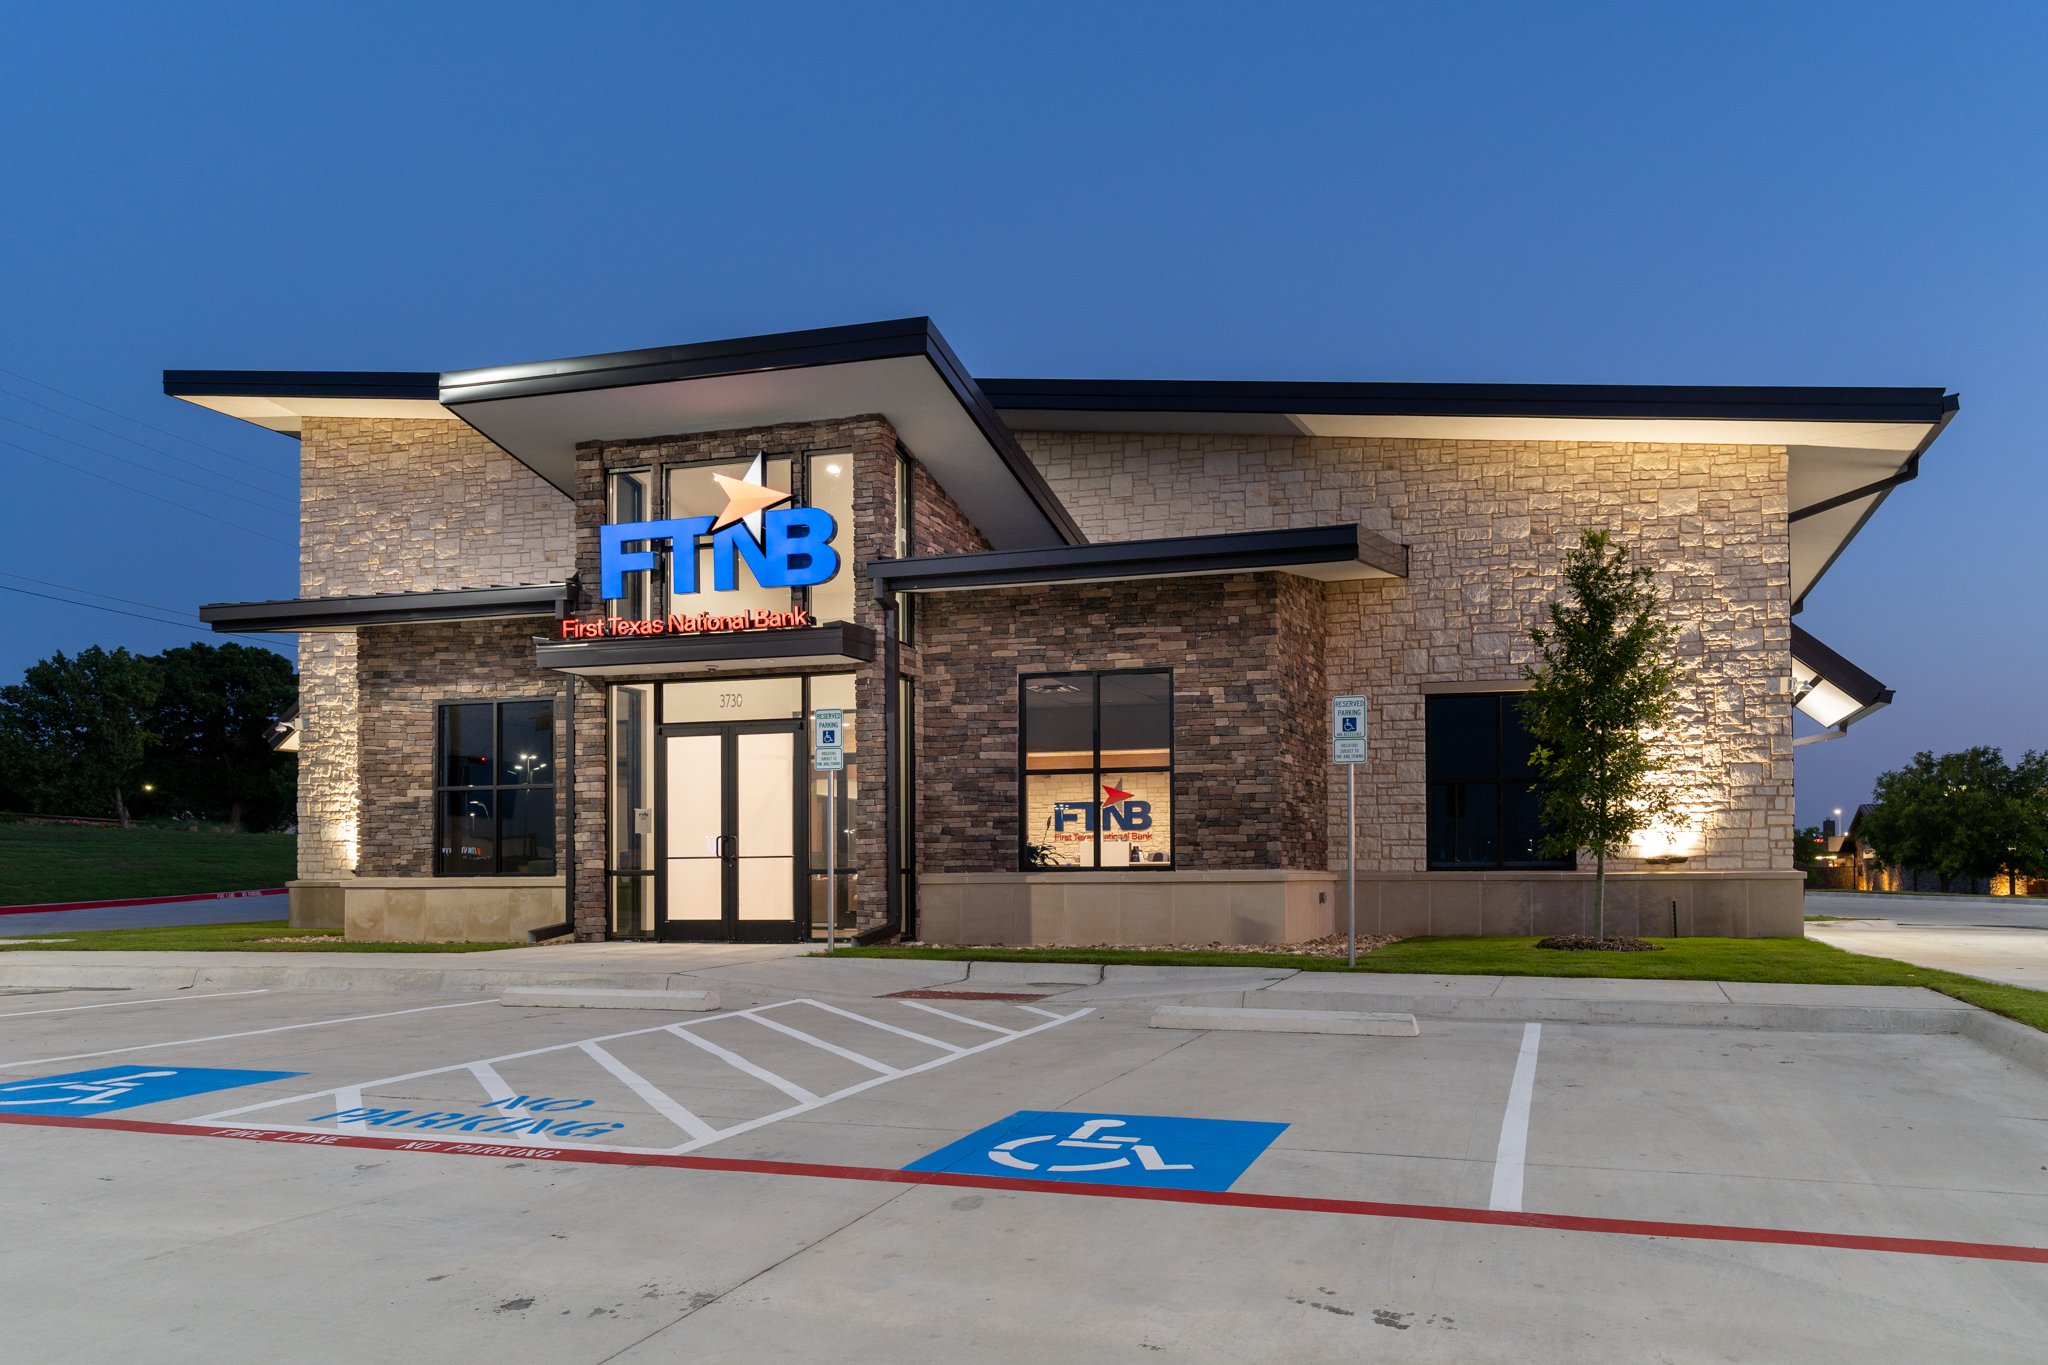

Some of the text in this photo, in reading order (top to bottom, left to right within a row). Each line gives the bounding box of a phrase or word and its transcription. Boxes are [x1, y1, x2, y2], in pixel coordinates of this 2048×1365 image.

[600, 507, 840, 600] FTNB
[562, 606, 807, 638] First Texas National Bank
[719, 693, 743, 708] 3730
[1054, 801, 1152, 832] FTNB
[1054, 832, 1072, 841] First
[1131, 832, 1152, 840] Bank
[477, 1095, 596, 1112] NO
[307, 1107, 625, 1138] PARKING
[209, 1129, 561, 1159] FIRE LANE NO PARKING
